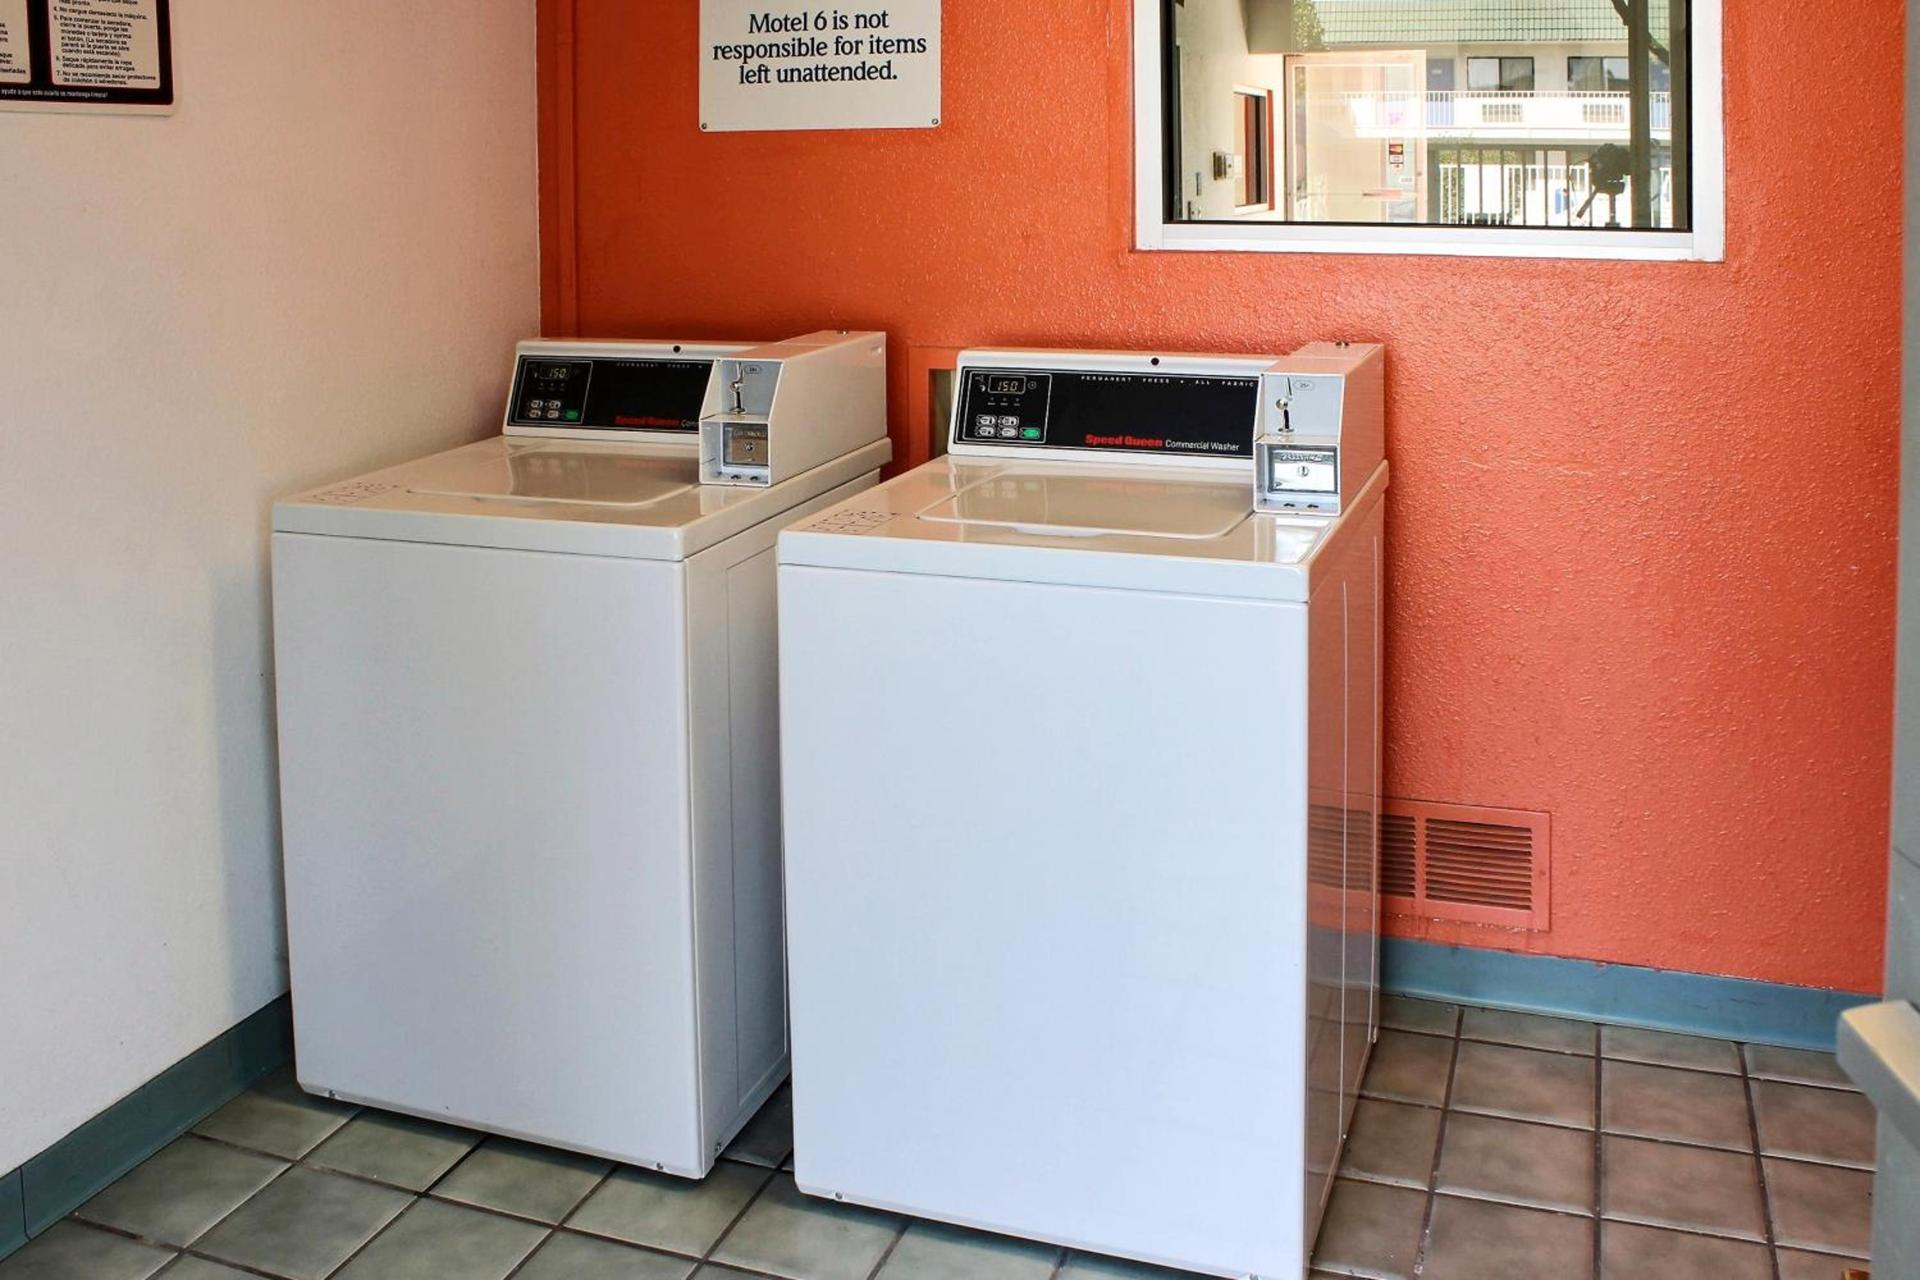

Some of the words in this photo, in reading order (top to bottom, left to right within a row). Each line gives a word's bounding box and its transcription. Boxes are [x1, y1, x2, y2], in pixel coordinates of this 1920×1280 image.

[748, 12, 808, 34] Motel
[813, 10, 828, 31] 6
[832, 10, 849, 30] is
[854, 10, 890, 30] not
[712, 37, 828, 64] responsible
[834, 36, 864, 56] for
[868, 34, 927, 54] items
[739, 64, 772, 84] left
[776, 60, 898, 84] unattended.
[998, 381, 1018, 392] 150
[1084, 434, 1123, 446] Speed
[1124, 435, 1163, 447] Queen
[1165, 439, 1210, 450] Commercial
[1210, 441, 1240, 451] Washer
